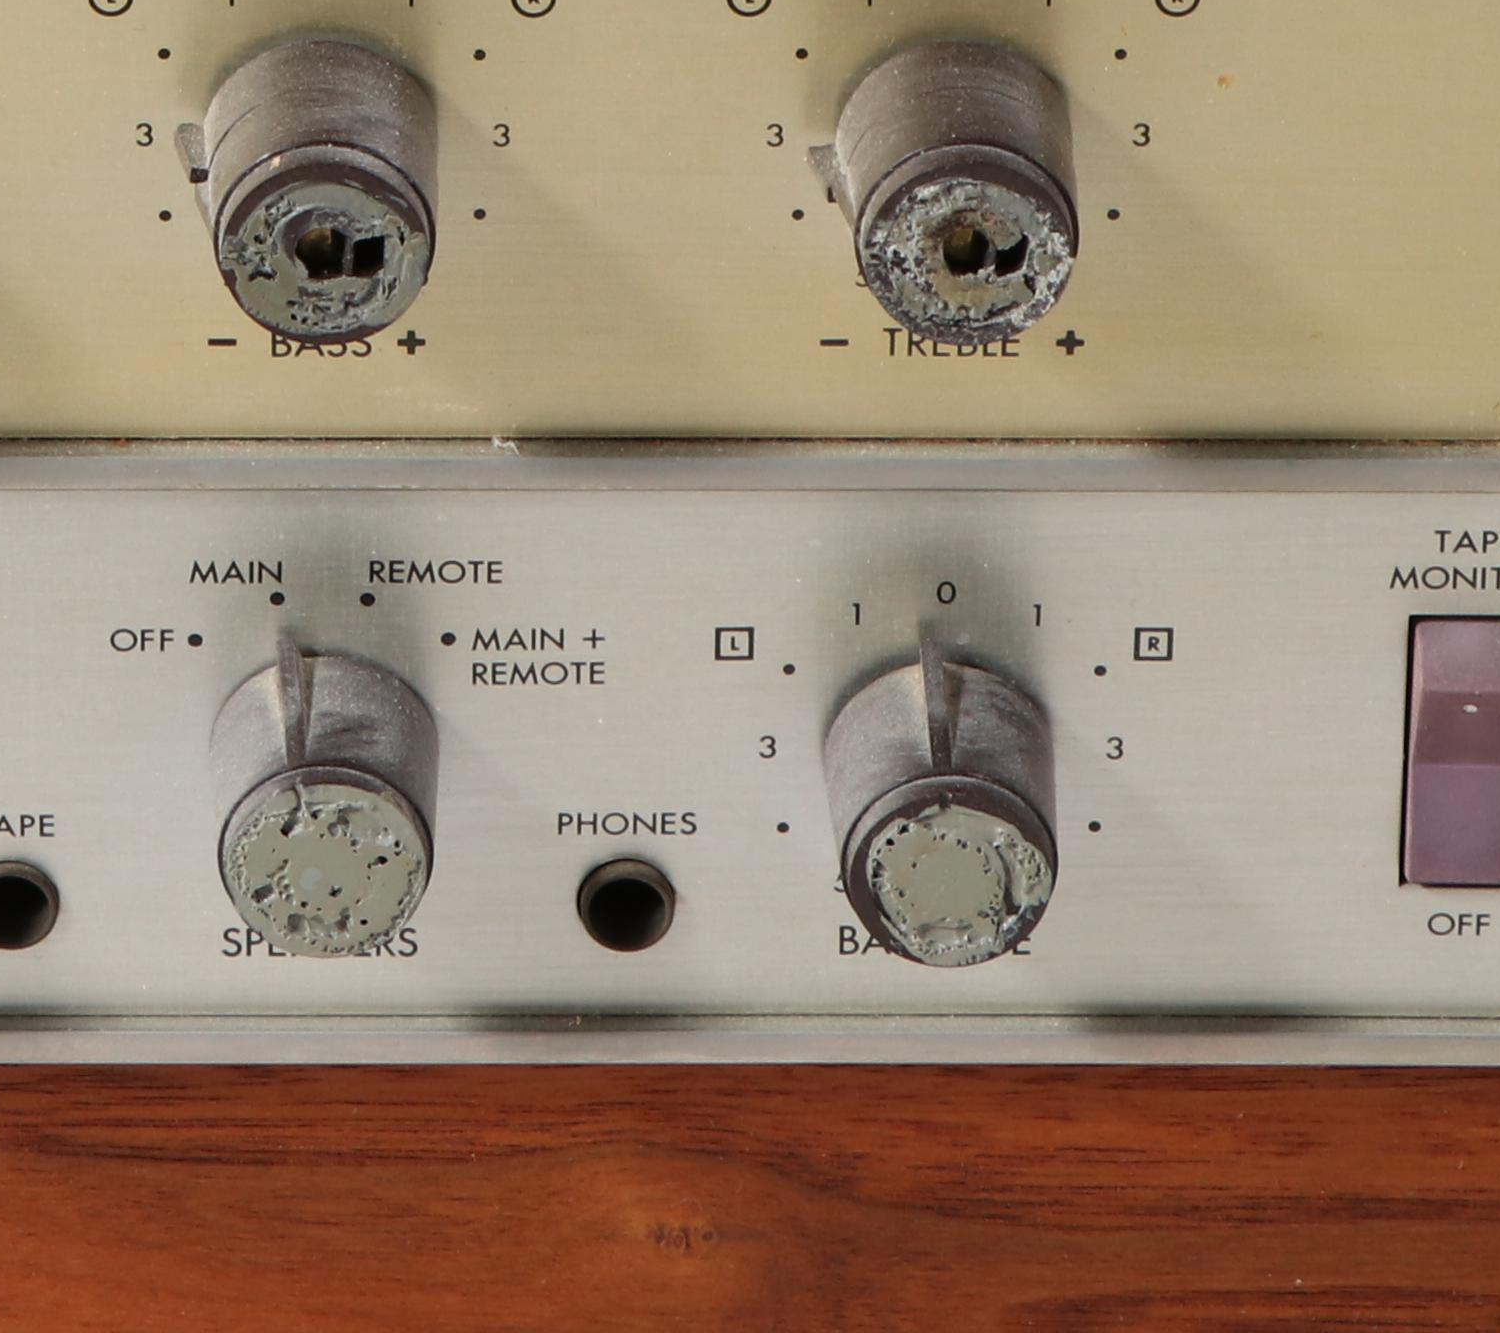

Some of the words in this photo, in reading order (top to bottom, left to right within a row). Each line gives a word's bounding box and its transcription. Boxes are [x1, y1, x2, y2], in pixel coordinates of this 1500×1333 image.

[136, 122, 154, 147] 3
[492, 123, 511, 148] 3
[766, 123, 784, 148] 3
[1132, 123, 1151, 147] 3
[189, 560, 283, 584] MAIN
[369, 560, 502, 584] REMOTE
[852, 602, 861, 626] 1
[936, 581, 957, 605] 0
[1033, 604, 1042, 627] 1
[110, 628, 174, 652] OFF
[471, 628, 565, 651] MAIN
[582, 628, 605, 650] +
[472, 661, 605, 686] REMOTE
[759, 735, 777, 759] 3
[1106, 736, 1124, 760] 3
[557, 811, 698, 836] PHONES
[1427, 912, 1490, 936] OFF
[222, 926, 419, 958] SPRS
